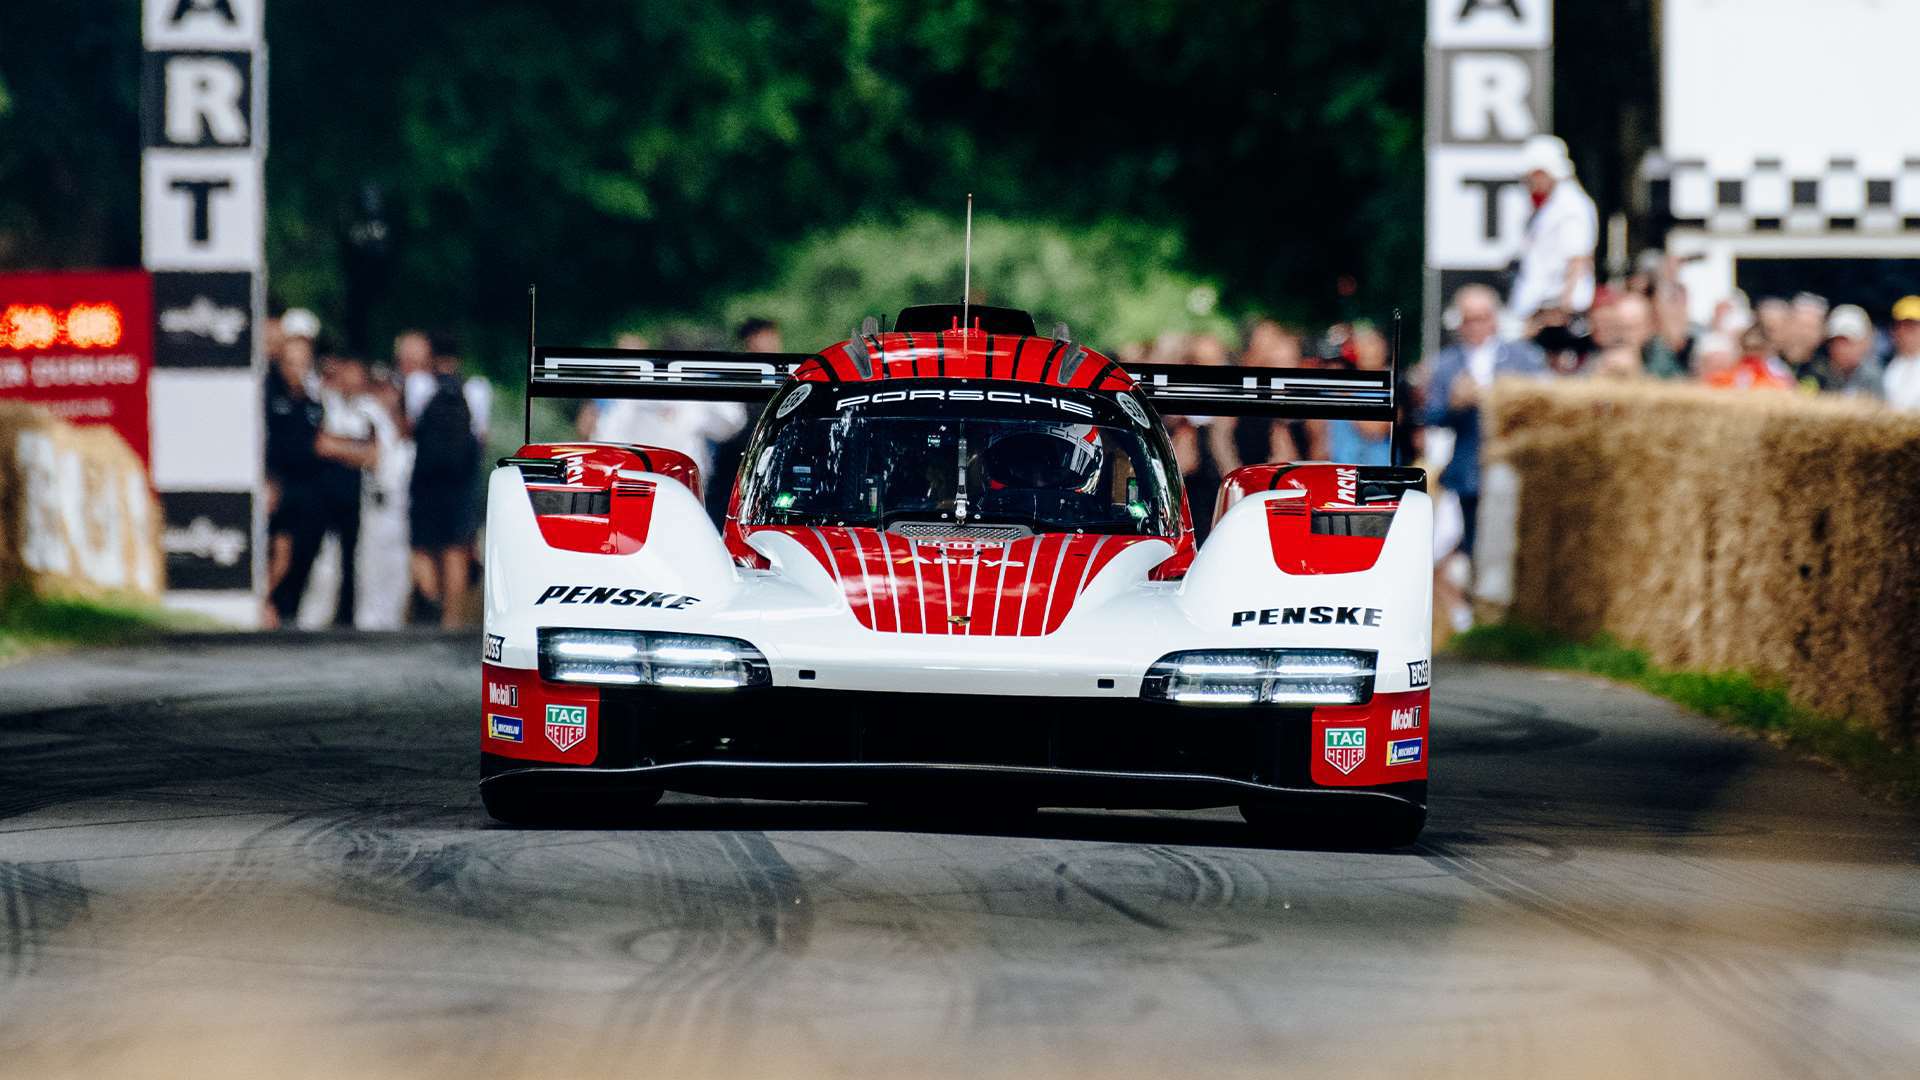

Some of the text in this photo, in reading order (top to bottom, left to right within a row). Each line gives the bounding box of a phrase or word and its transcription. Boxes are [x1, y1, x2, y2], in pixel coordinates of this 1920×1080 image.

[164, 0, 248, 245] RT
[1450, 0, 1535, 241] RT
[836, 390, 1093, 418] PORSCHE
[535, 585, 701, 609] PENSKE
[1232, 606, 1383, 627] PENSKE
[489, 682, 510, 706] Mobil
[549, 708, 583, 723] TAG
[1391, 707, 1413, 730] Mobil
[547, 725, 584, 748] HEUER
[1329, 731, 1363, 746] TAG
[1328, 749, 1364, 771] HEUER
